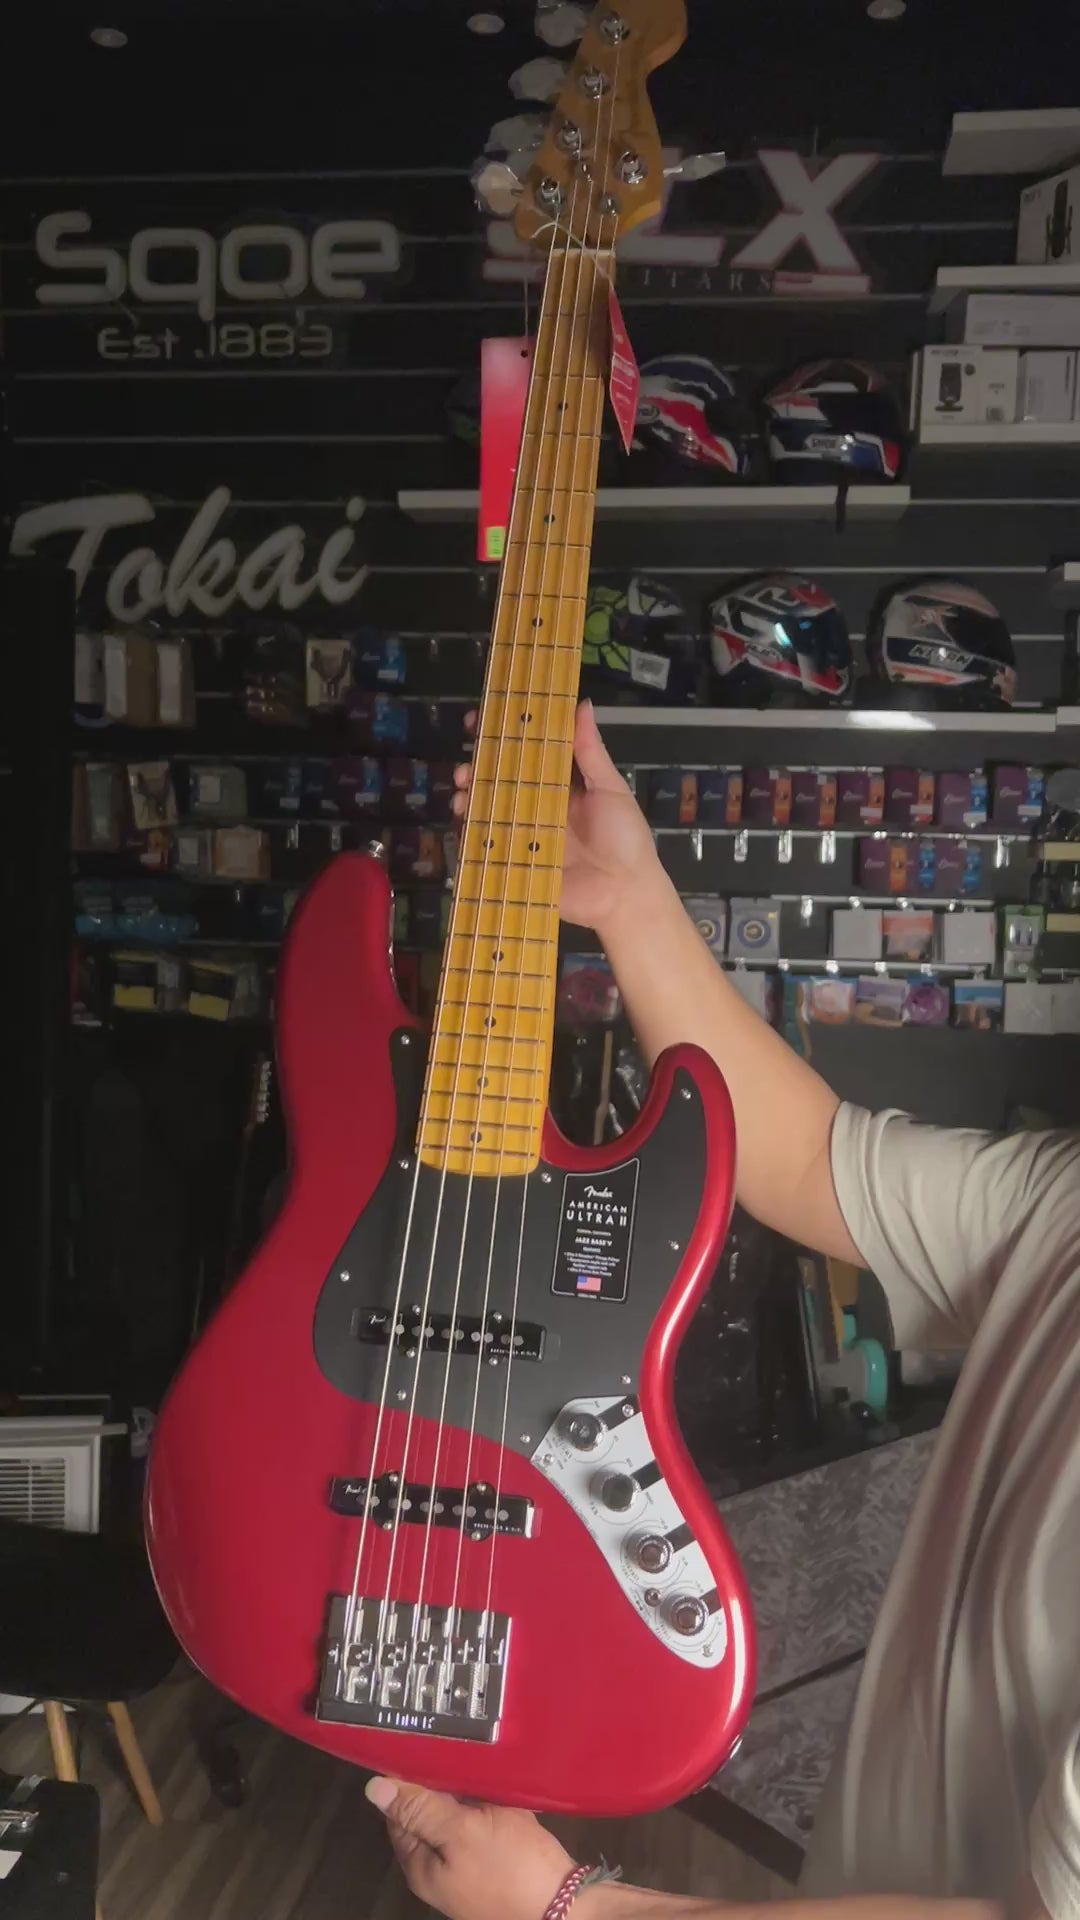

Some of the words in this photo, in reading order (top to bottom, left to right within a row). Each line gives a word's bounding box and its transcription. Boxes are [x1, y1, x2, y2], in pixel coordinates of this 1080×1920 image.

[36, 210, 400, 321] Sqoe
[8, 485, 369, 623] Tokai
[566, 1209, 614, 1225] ULTRA
[619, 1215, 627, 1227] II
[569, 1200, 627, 1213] AMERICAN
